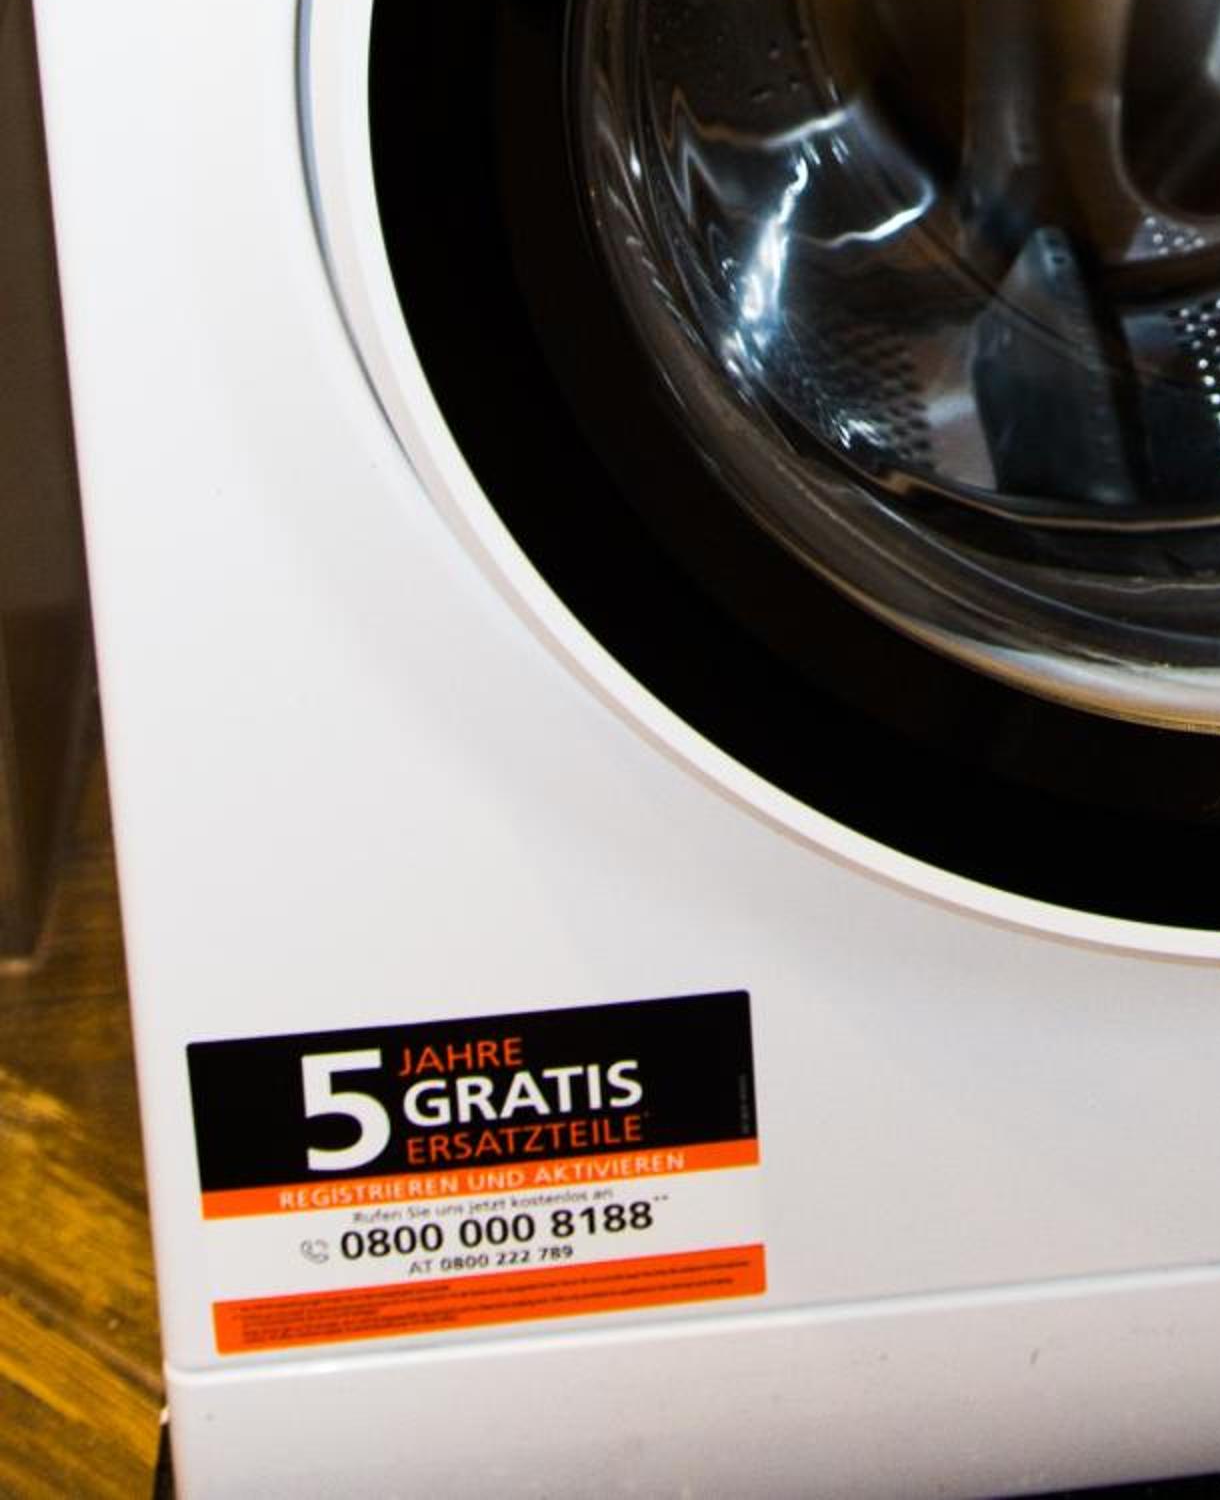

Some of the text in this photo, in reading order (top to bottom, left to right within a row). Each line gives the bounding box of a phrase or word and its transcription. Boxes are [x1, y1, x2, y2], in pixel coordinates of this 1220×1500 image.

[301, 1037, 524, 1171] 5 JAHRE
[403, 1059, 643, 1127] GRATIS
[405, 1116, 643, 1166] ERSATZTEILE
[279, 1153, 686, 1209] REGISTRIEREN UND AKTIVIEREN
[407, 1207, 431, 1218] Sie
[435, 1205, 464, 1216] uns
[468, 1198, 506, 1215] jetzt
[511, 1187, 587, 1208] kostenlos
[593, 1188, 613, 1200] an
[341, 1222, 443, 1261] 0800
[459, 1212, 536, 1248] 000
[408, 1245, 573, 1275] AT 0800 222 789
